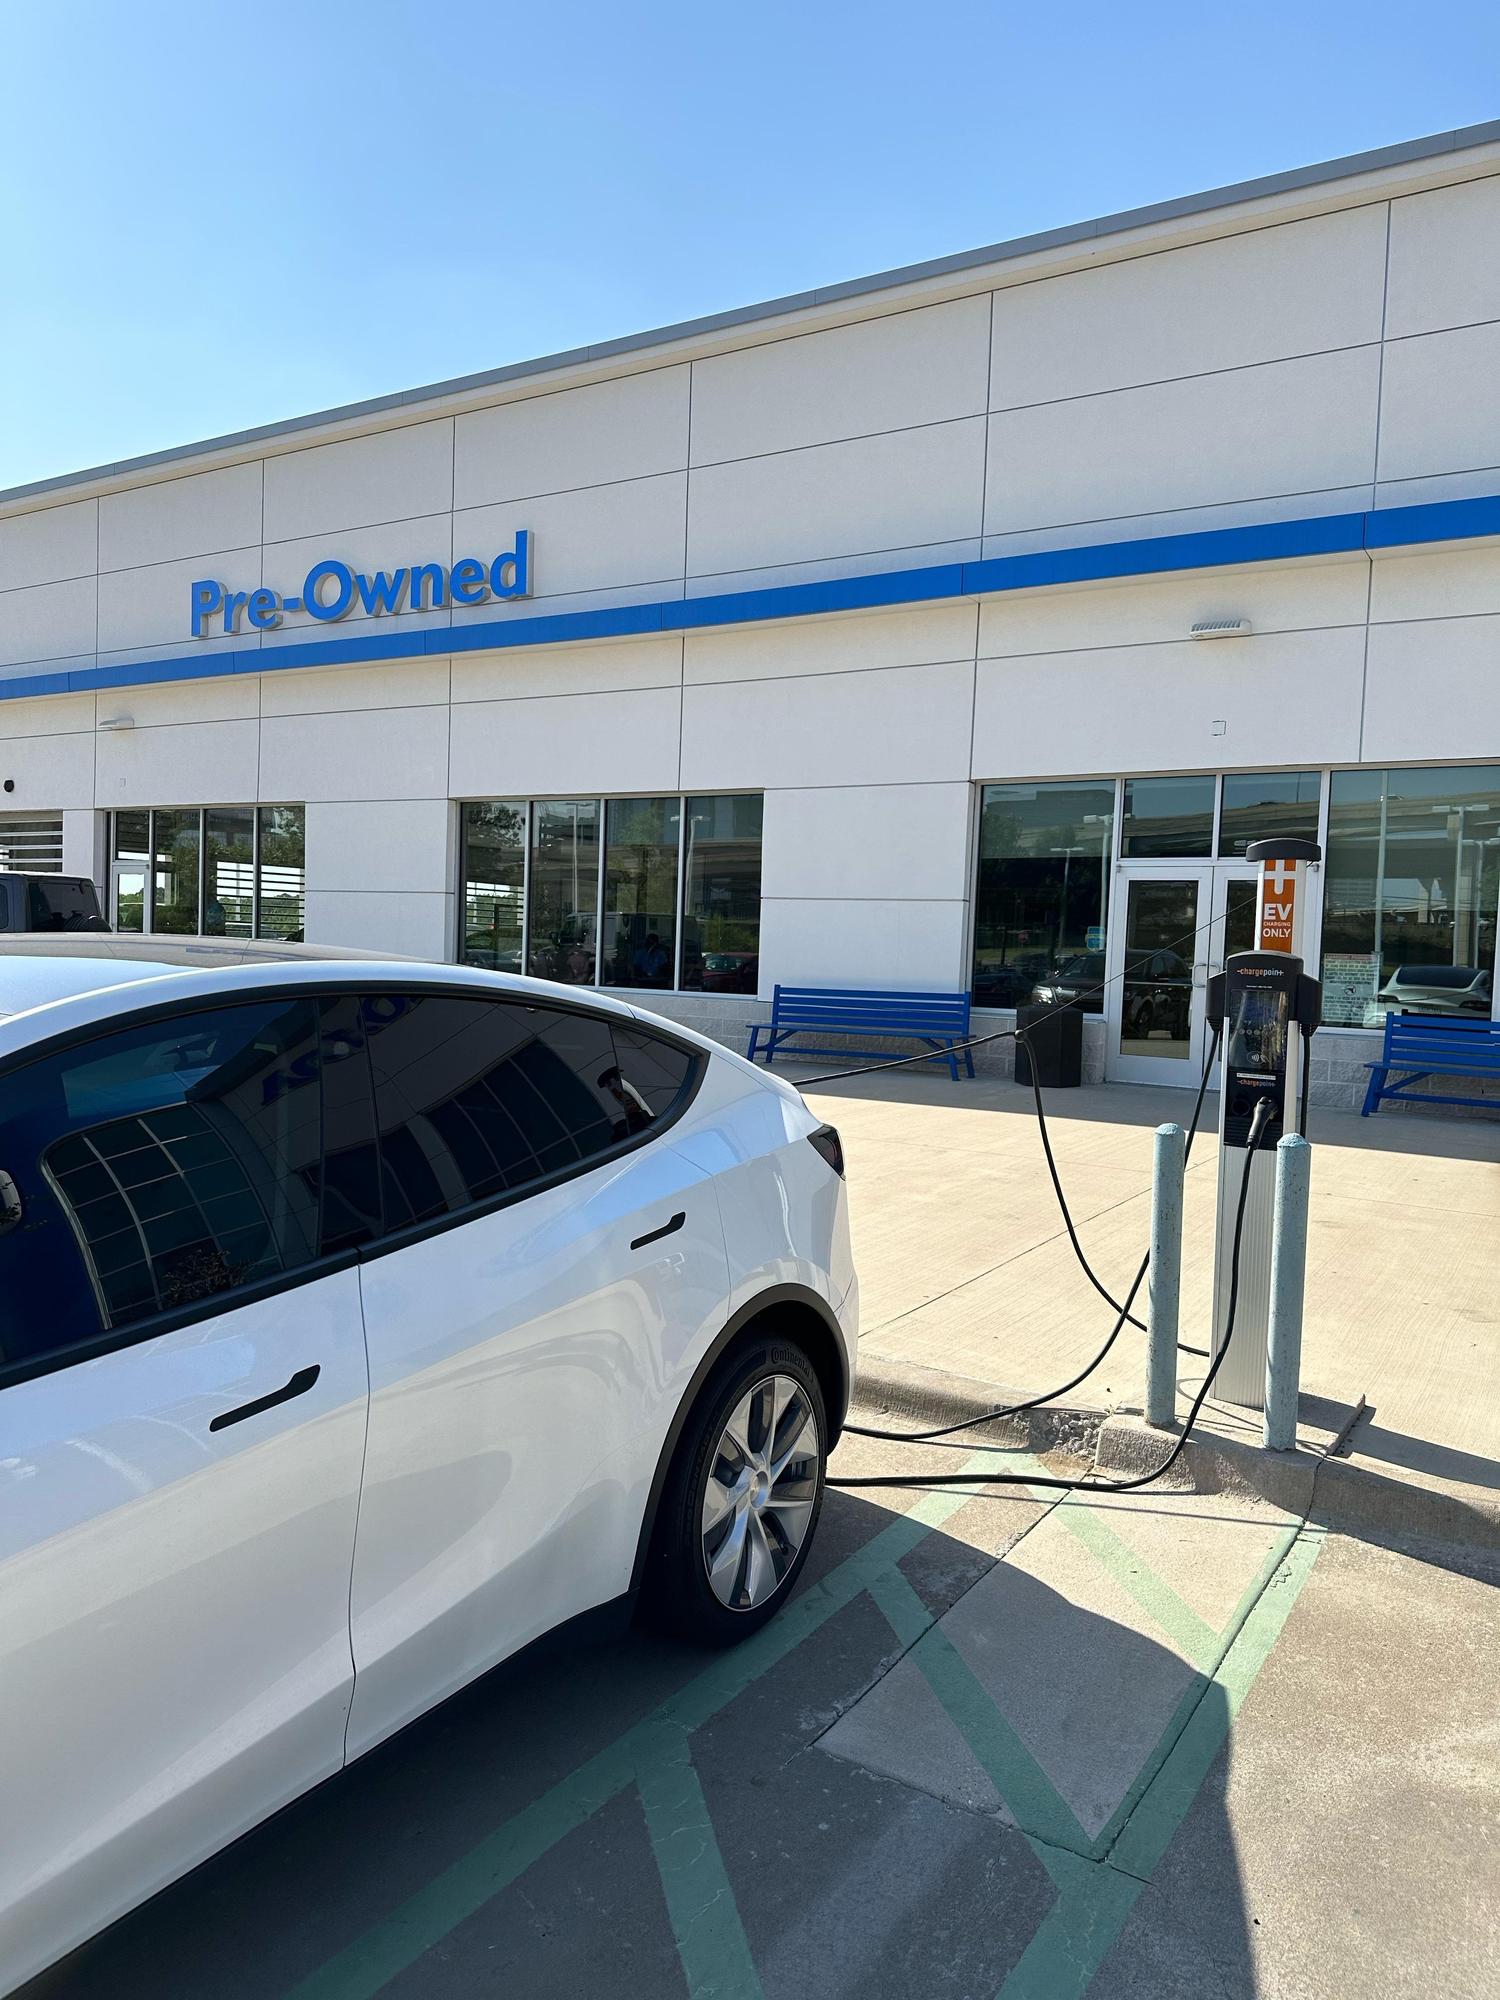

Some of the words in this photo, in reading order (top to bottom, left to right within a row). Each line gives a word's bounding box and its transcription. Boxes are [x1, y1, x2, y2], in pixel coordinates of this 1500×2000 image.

[191, 529, 533, 638] Pre-Owned
[1263, 903, 1292, 920] EV
[1262, 928, 1291, 938] ONLY
